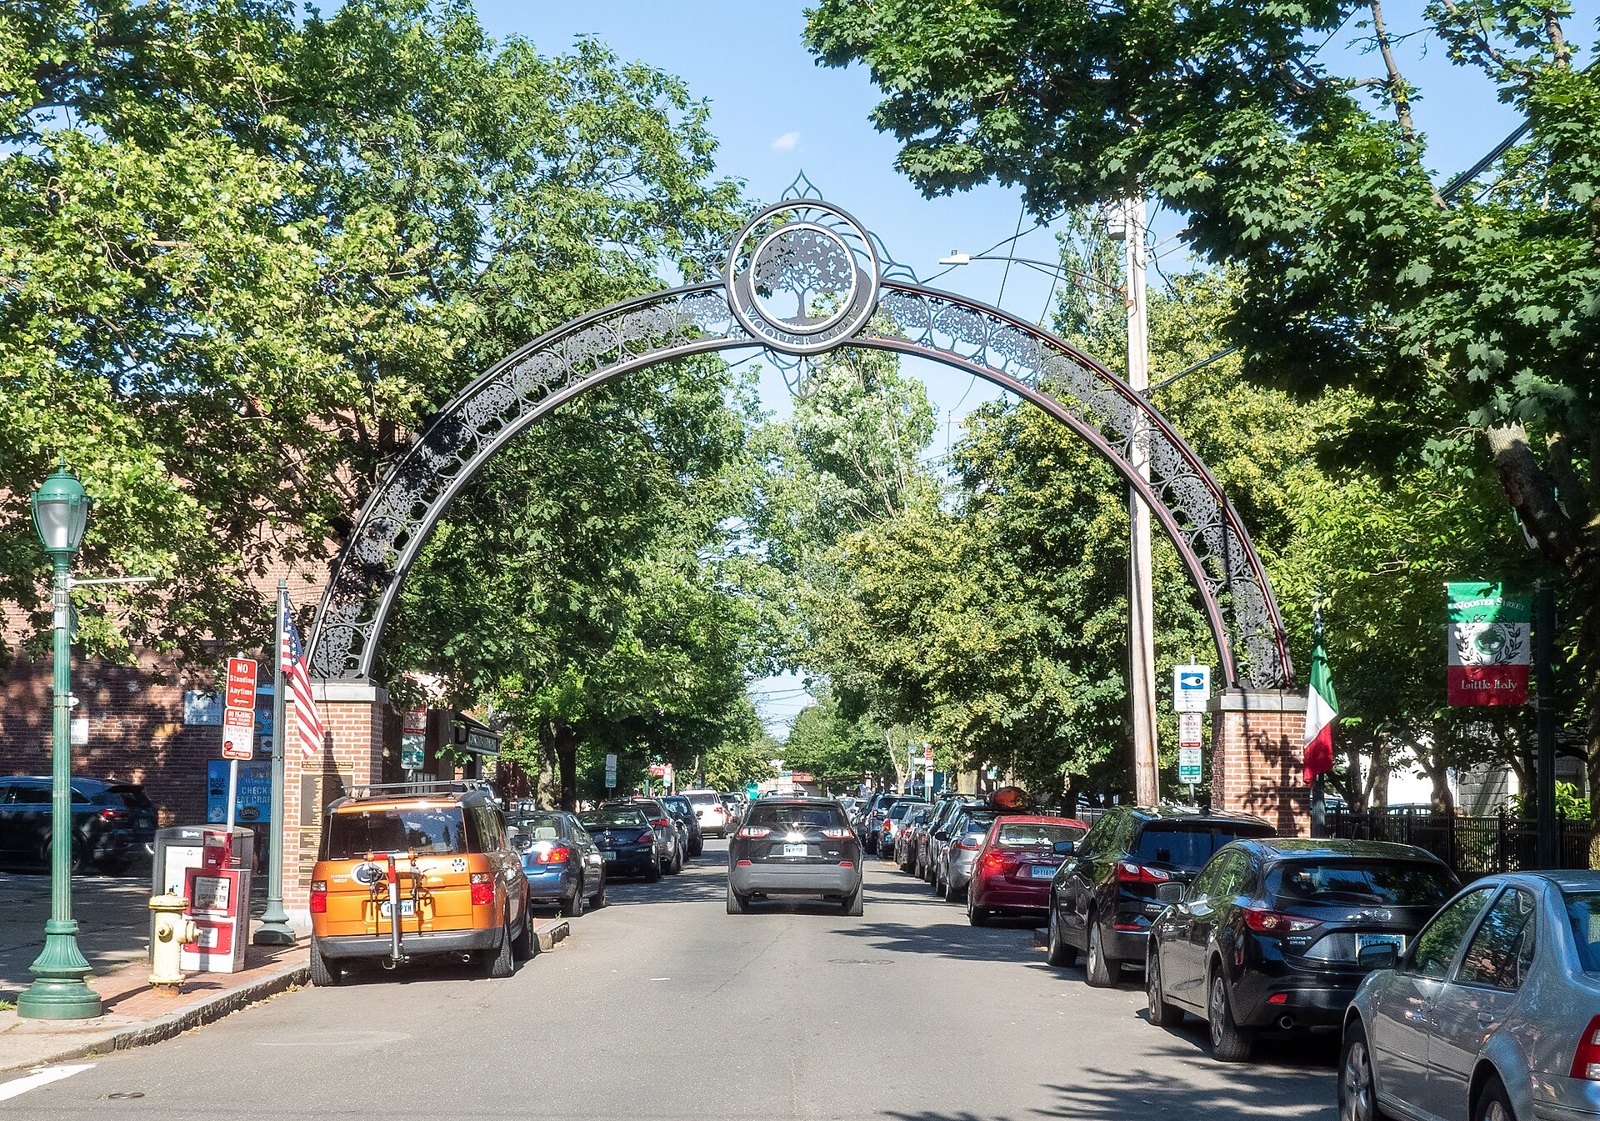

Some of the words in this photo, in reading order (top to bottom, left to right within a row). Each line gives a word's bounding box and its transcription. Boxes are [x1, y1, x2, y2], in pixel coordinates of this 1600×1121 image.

[744, 305, 811, 345] WOOSTER
[1454, 598, 1495, 611] WOOSTER
[1496, 597, 1525, 611] STREET
[236, 663, 249, 674] NO
[229, 674, 254, 686] Standing
[1461, 679, 1491, 690] Little
[1494, 679, 1517, 692] Italy
[229, 686, 253, 696] Anytime
[241, 786, 267, 795] CHECK
